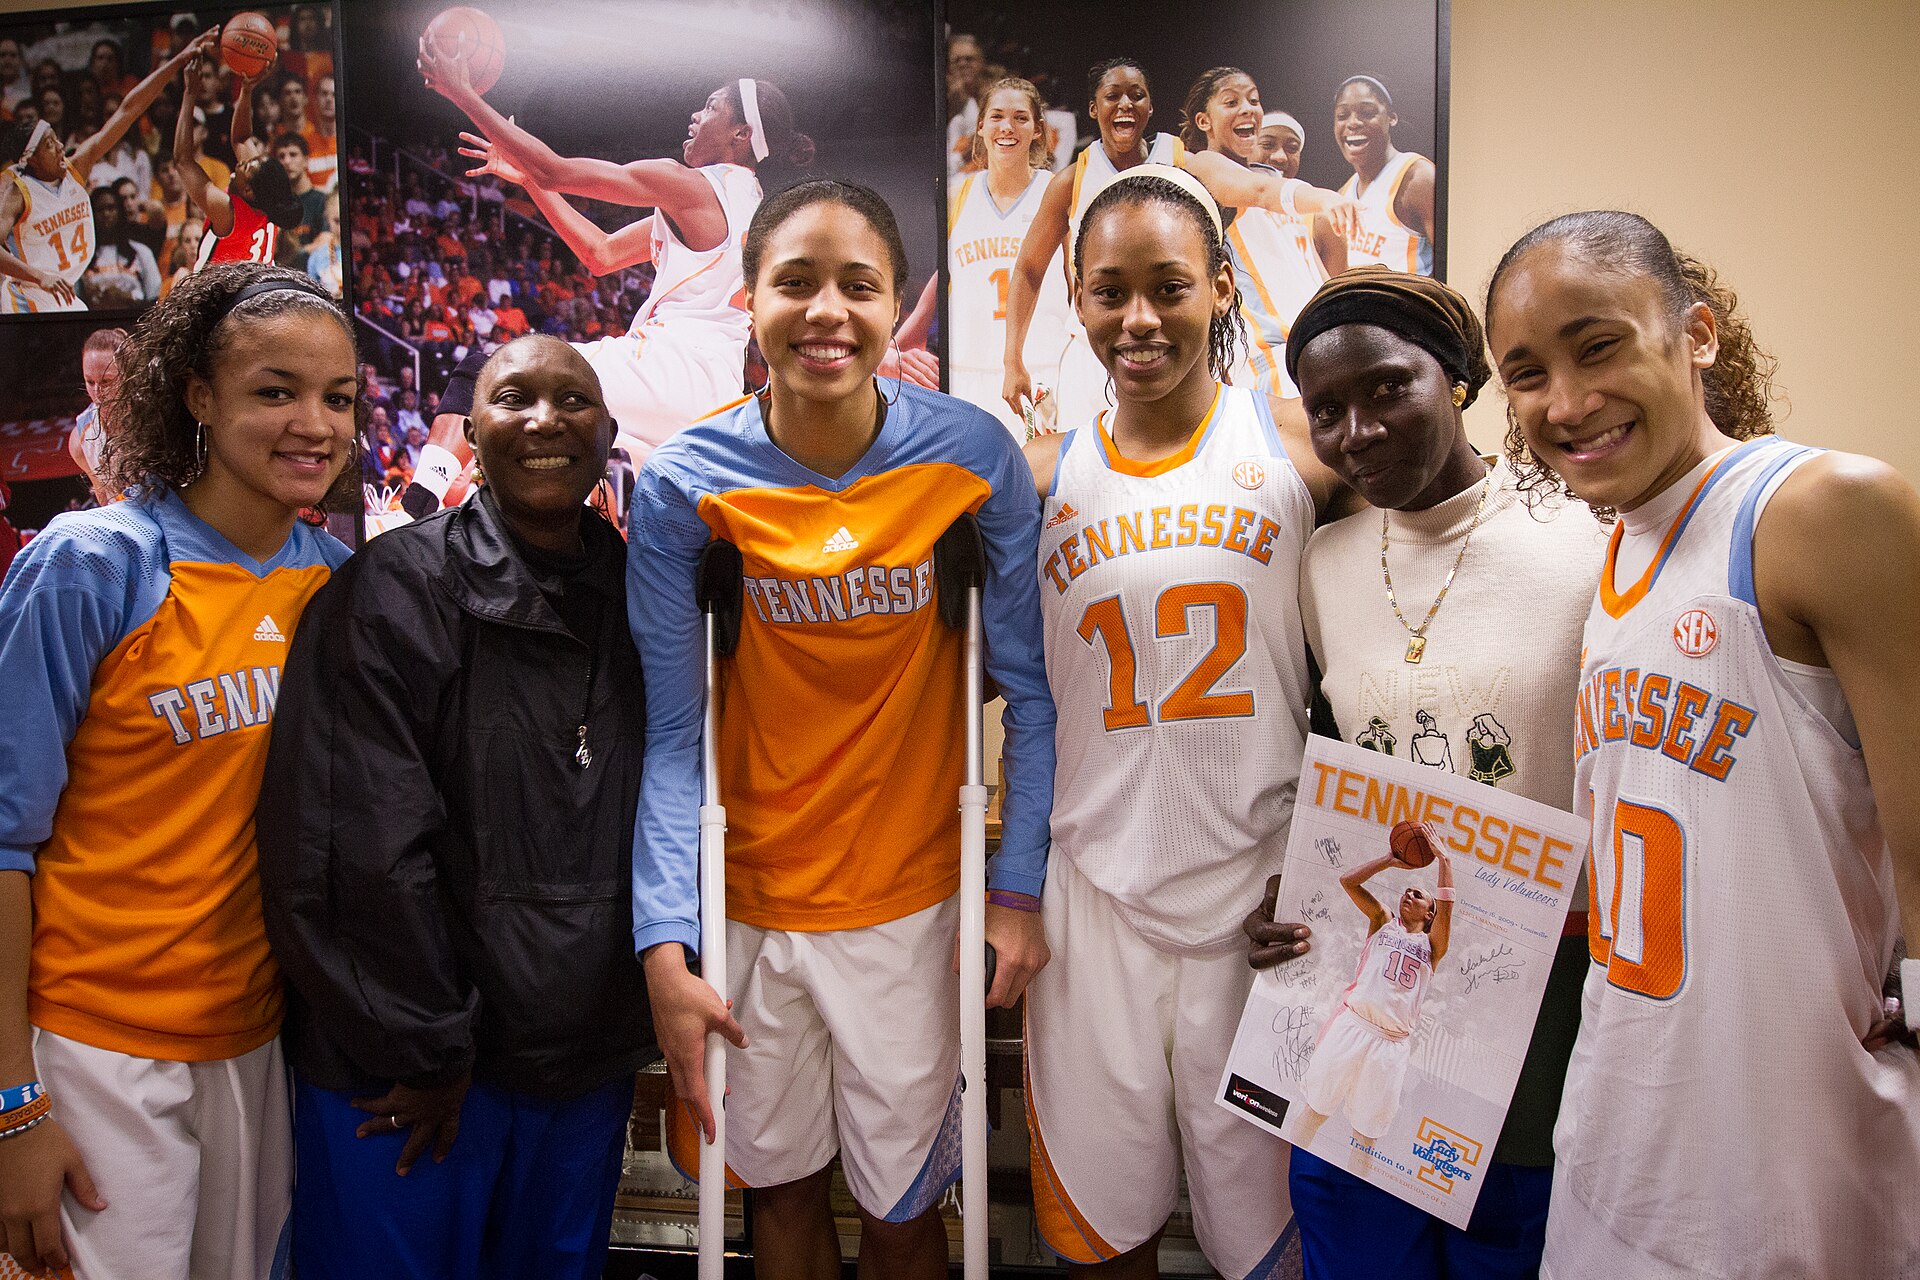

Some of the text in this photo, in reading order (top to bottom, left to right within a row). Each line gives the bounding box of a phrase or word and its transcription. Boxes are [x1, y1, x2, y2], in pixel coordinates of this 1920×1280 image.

[48, 222, 88, 271] 14
[250, 222, 274, 263] 31
[1234, 463, 1265, 488] SEC
[1046, 509, 1079, 529] adidas
[822, 540, 859, 554] adidas
[1043, 503, 1282, 595] TENNESSEE
[743, 560, 935, 623] TENNESSE
[253, 632, 286, 643] adidas
[1676, 611, 1716, 655] SEC
[1076, 580, 1256, 732] 12
[147, 665, 280, 746] TENN
[1312, 761, 1574, 890] TENNESSEE
[1460, 899, 1488, 915] December
[1475, 866, 1560, 908] Lady Volunteers
[1383, 950, 1422, 989] 15
[1349, 1136, 1393, 1166] Tradition
[1395, 1162, 1405, 1172] to
[1412, 1142, 1473, 1181] Volunteers
[1429, 1138, 1460, 1163] Lady
